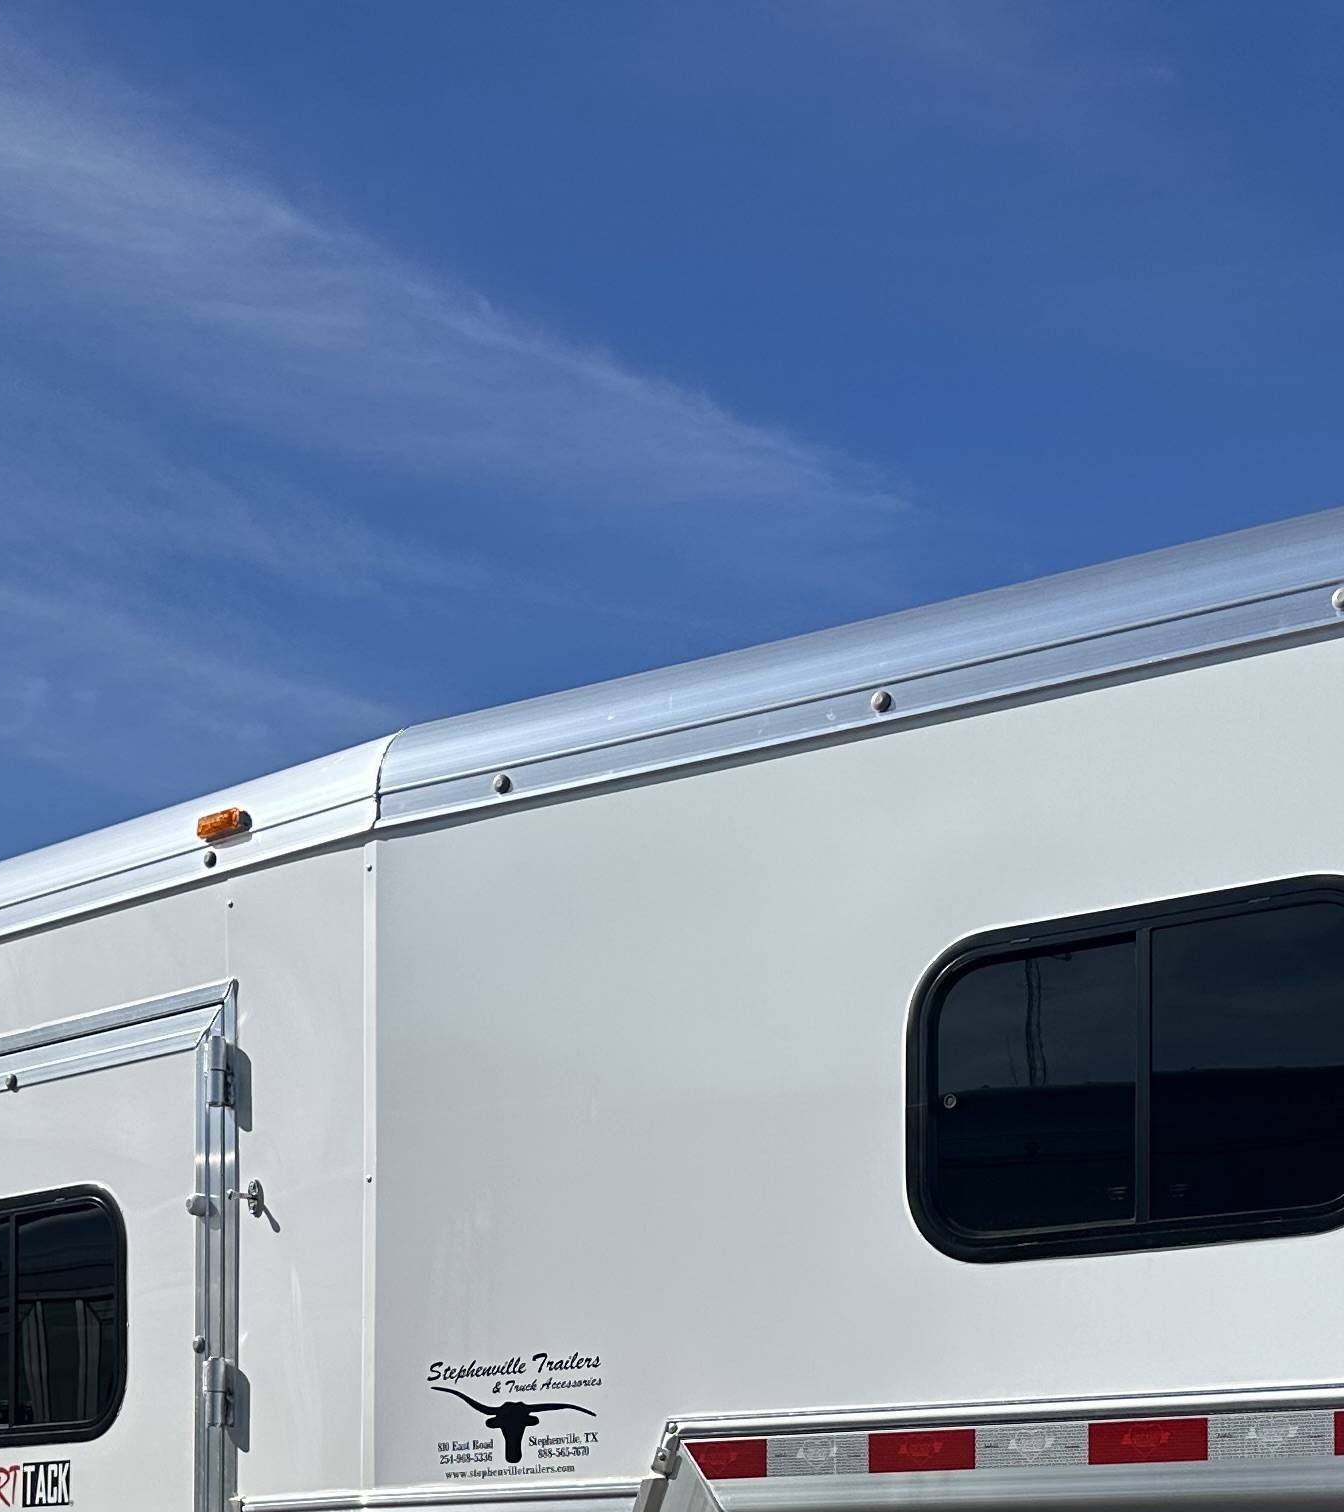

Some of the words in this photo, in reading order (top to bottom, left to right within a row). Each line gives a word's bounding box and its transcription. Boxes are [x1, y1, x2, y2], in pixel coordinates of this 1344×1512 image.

[426, 1356, 527, 1386] Stephenville
[531, 1351, 602, 1374] Trailers
[491, 1381, 502, 1394] &
[505, 1378, 538, 1394] Truck
[539, 1376, 603, 1391] Accessories
[452, 1440, 470, 1452] East
[472, 1438, 494, 1450] Road
[528, 1433, 582, 1447] Stephenville,
[584, 1431, 599, 1443] TX
[444, 1463, 575, 1480] www.stephenvilletrailers.com
[23, 1462, 70, 1506] TACK
